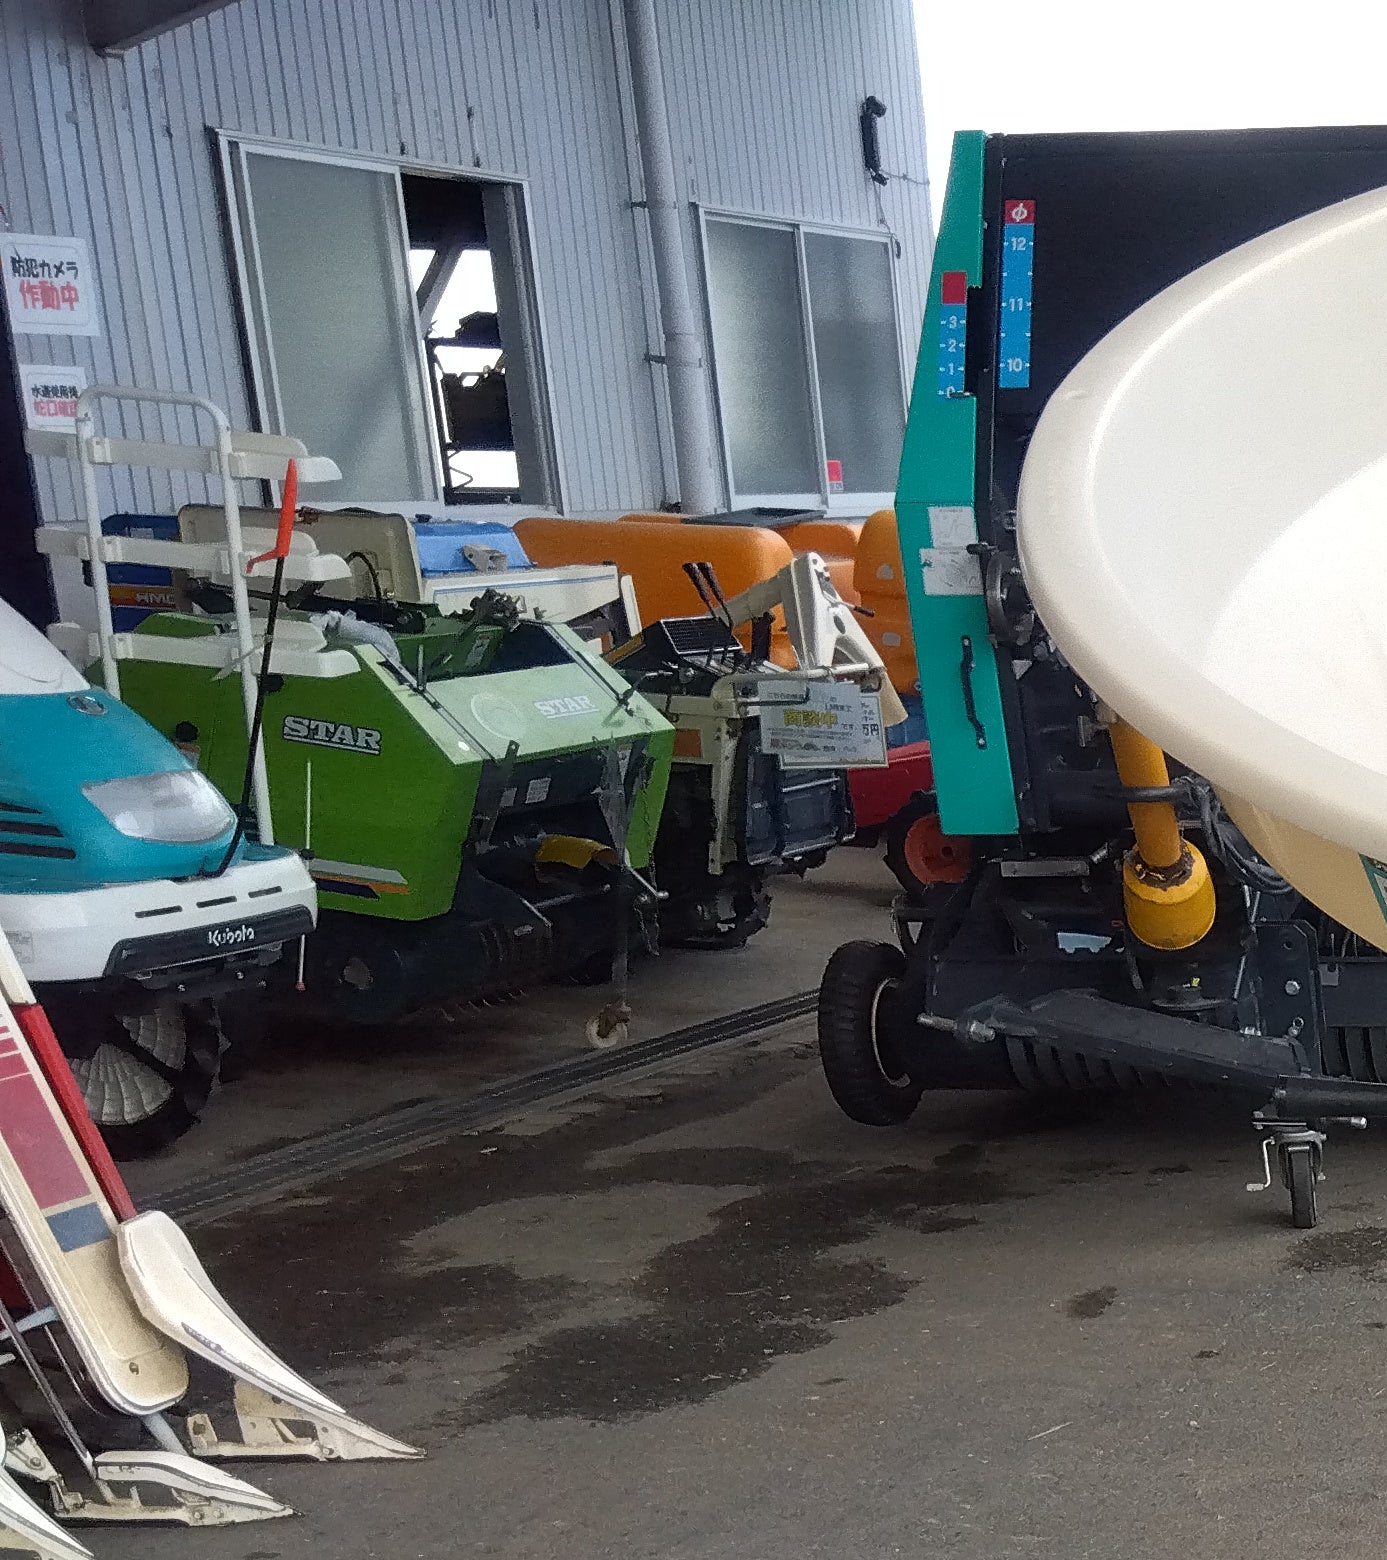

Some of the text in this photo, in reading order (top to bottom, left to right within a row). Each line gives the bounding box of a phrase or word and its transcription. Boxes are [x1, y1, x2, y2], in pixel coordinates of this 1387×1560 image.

[1010, 237, 1026, 250] 12
[10, 255, 79, 280] 防犯カメラ
[19, 279, 79, 311] 作動中
[1009, 298, 1024, 311] 11
[949, 316, 957, 328] 3
[948, 339, 956, 352] 2
[948, 363, 954, 375] 1
[1007, 358, 1022, 371] 10
[533, 695, 596, 716] STAR
[282, 715, 382, 751] STAR
[207, 925, 255, 947] Kubota
